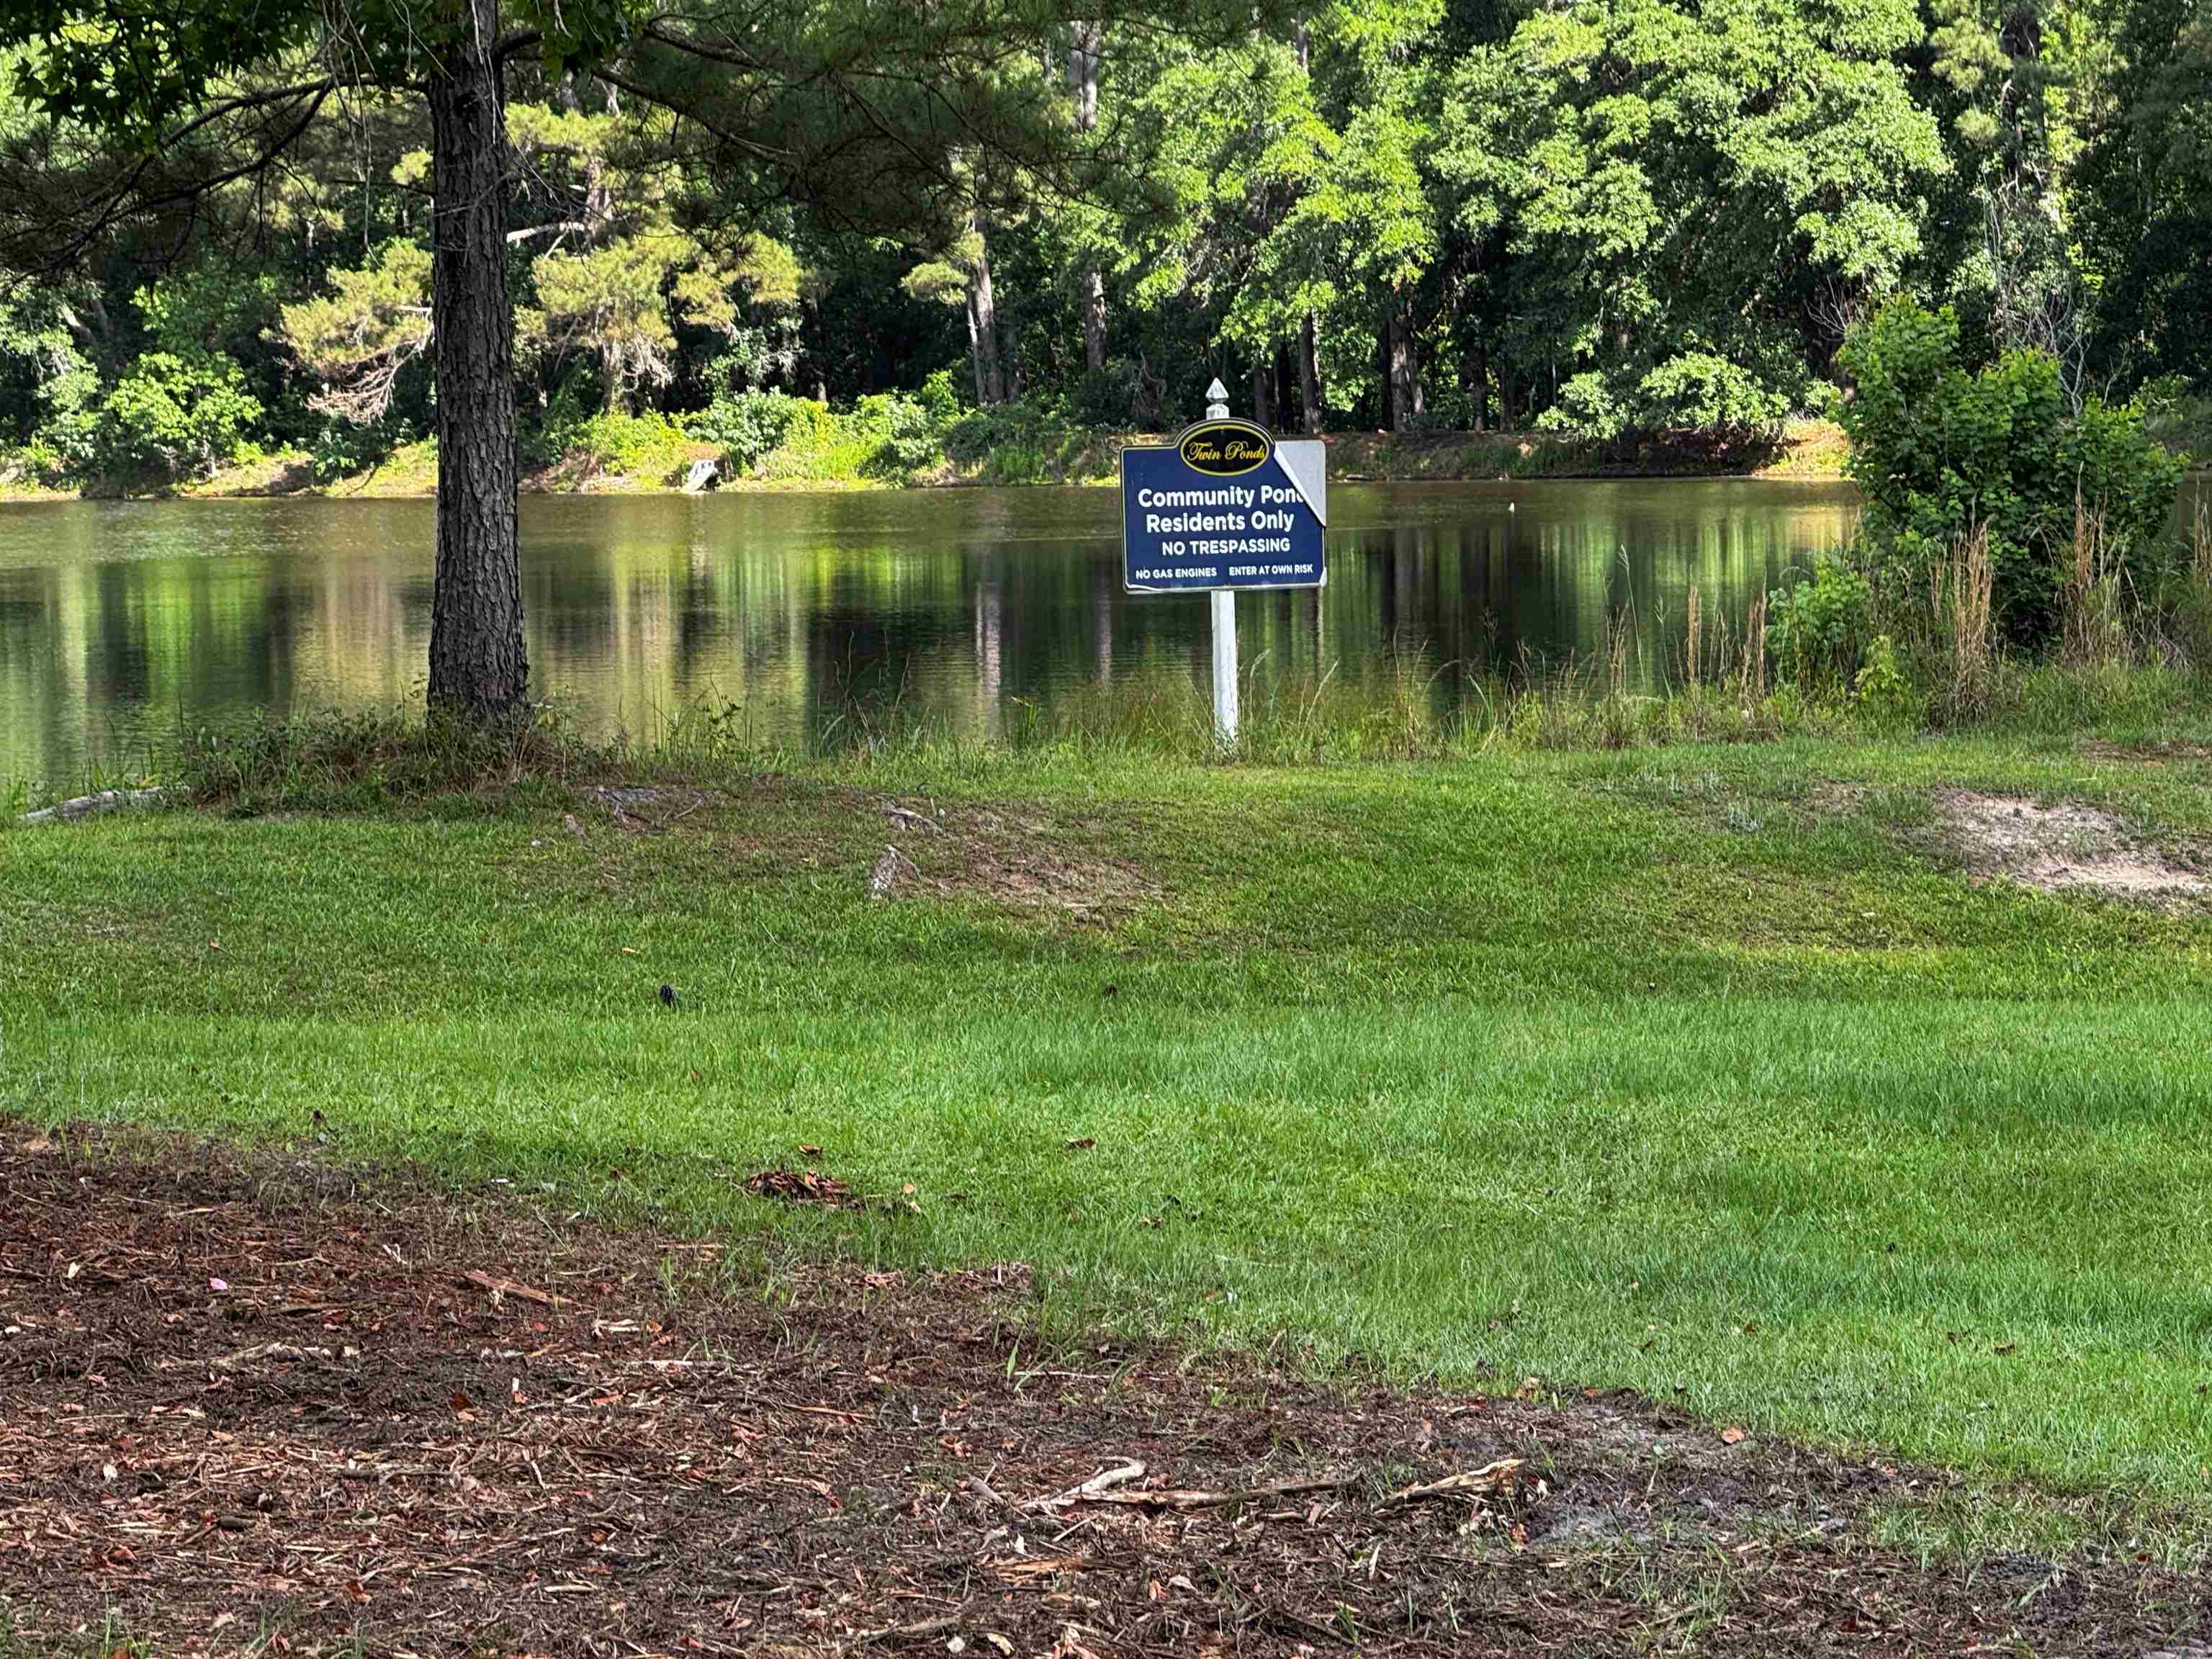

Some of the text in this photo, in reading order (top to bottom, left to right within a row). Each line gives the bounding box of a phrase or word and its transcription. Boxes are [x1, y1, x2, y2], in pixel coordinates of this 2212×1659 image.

[1187, 441, 1267, 461] Twin Ponds
[1138, 486, 1254, 508] Community
[1146, 512, 1294, 533] Residents Only
[1162, 539, 1290, 555] NO TRESPASSING
[1136, 567, 1217, 579] NO GAS ENGINES
[1229, 565, 1313, 576] ENTER AT OWN RISK
